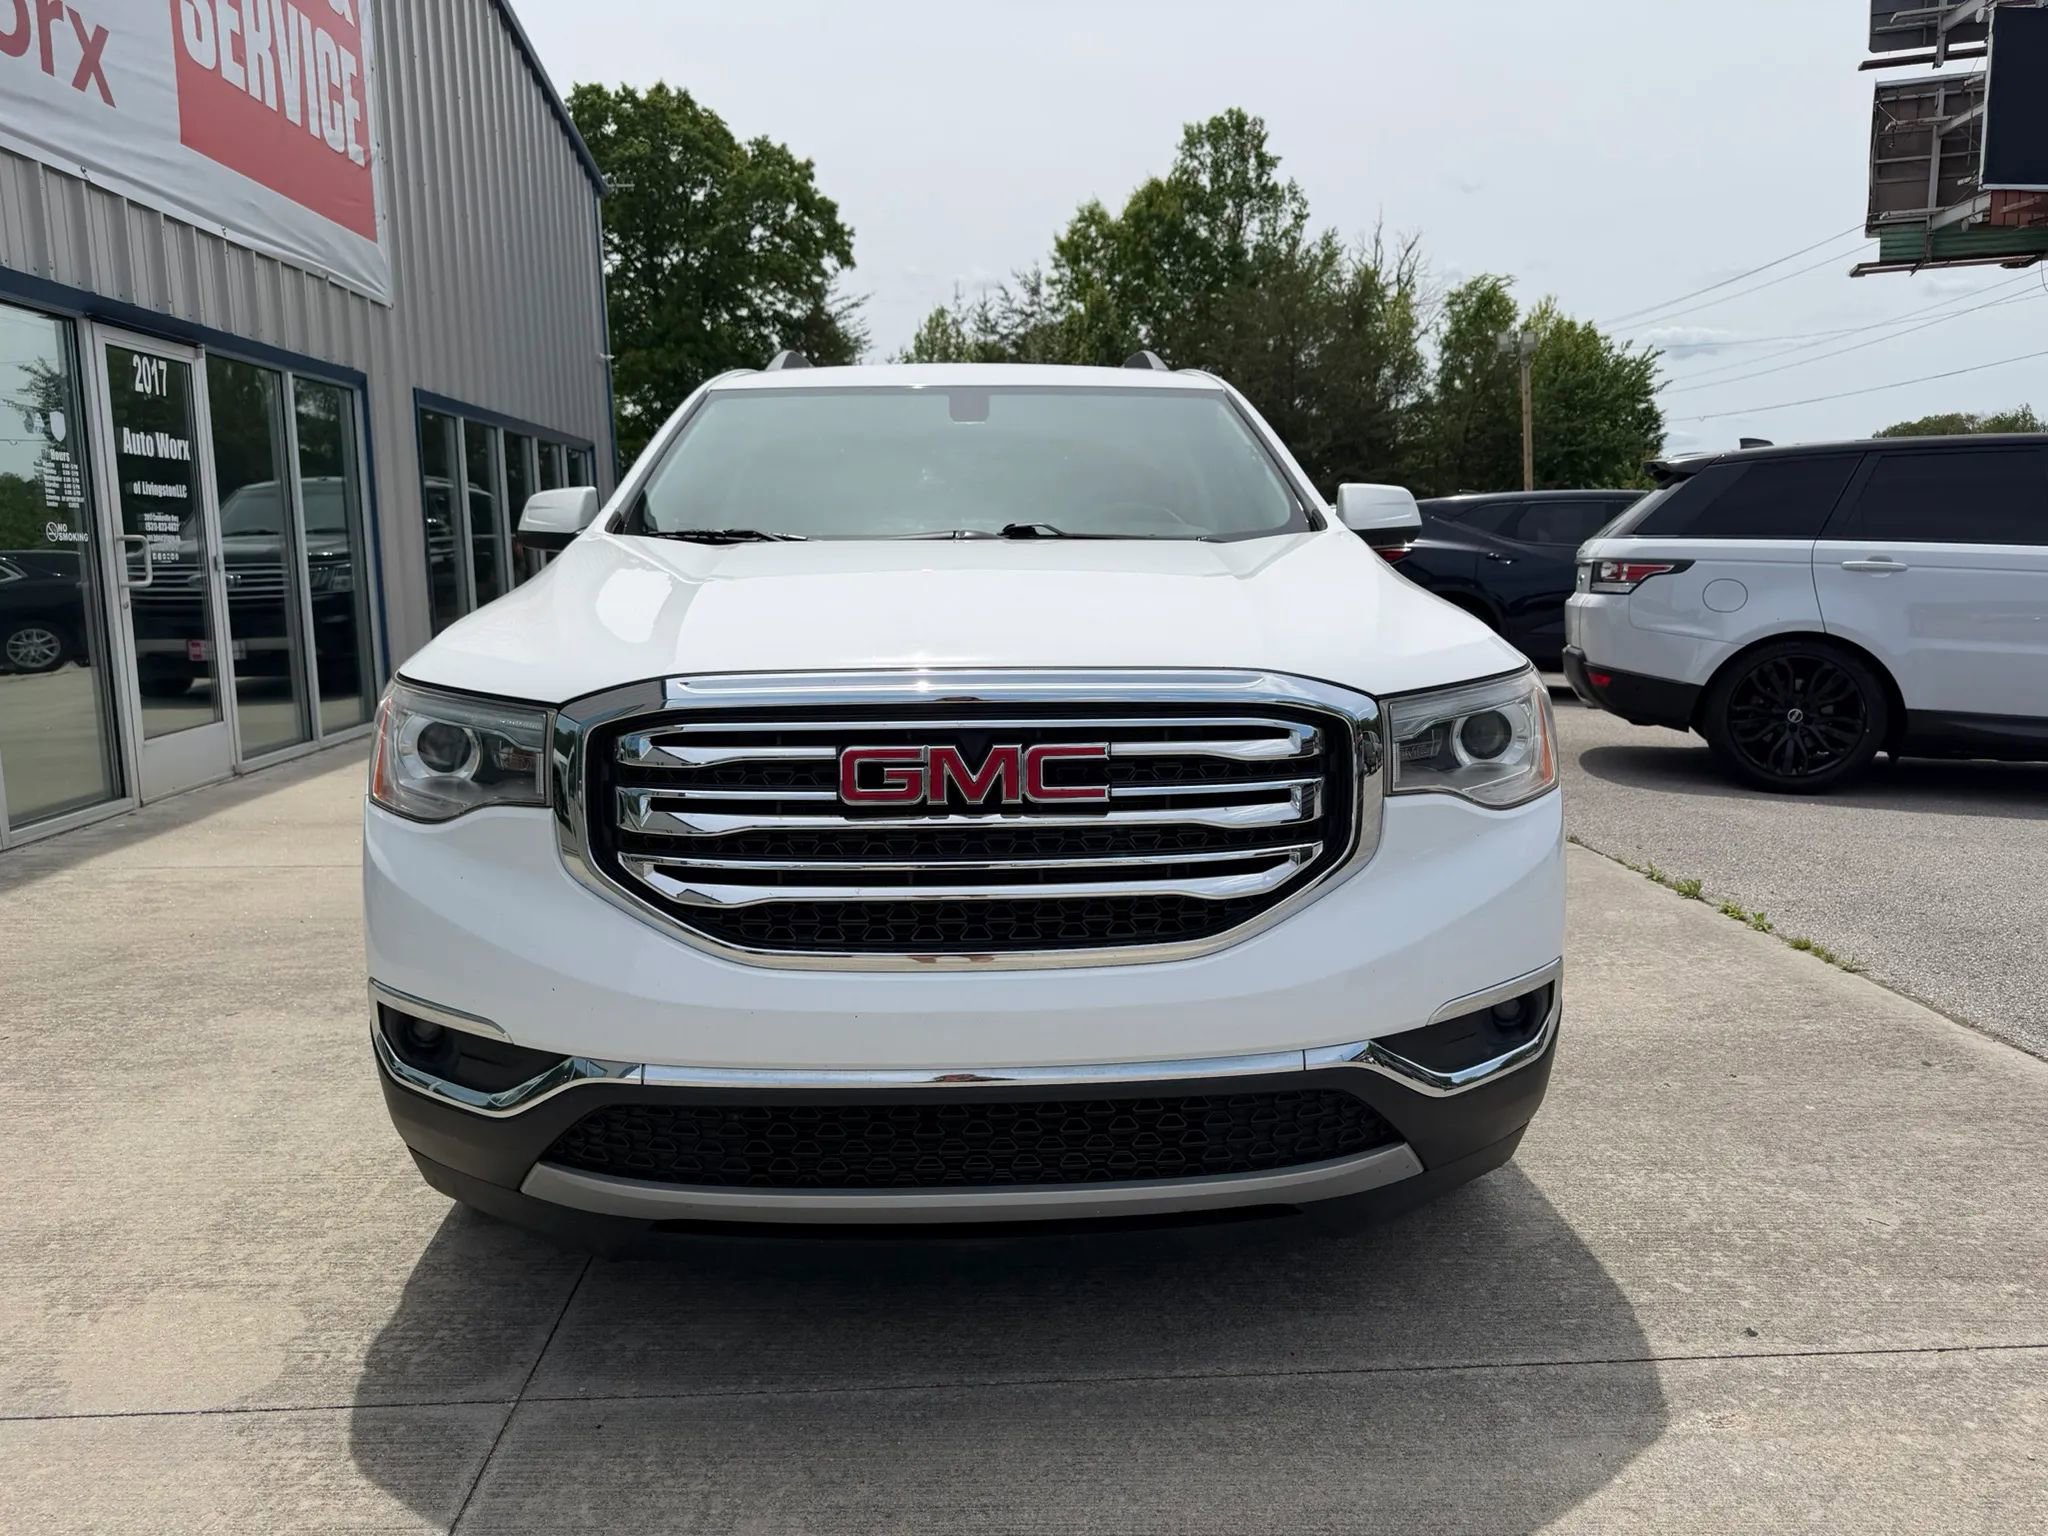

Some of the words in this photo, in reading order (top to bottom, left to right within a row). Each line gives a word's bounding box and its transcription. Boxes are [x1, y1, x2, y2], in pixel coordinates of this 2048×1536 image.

[132, 353, 168, 397] 2017
[123, 426, 154, 458] Auto
[155, 431, 191, 461] Worx
[50, 448, 70, 462] Hours
[133, 480, 141, 495] of
[57, 522, 68, 532] NO
[58, 532, 89, 542] SMOKING
[839, 742, 1111, 806] GMC
